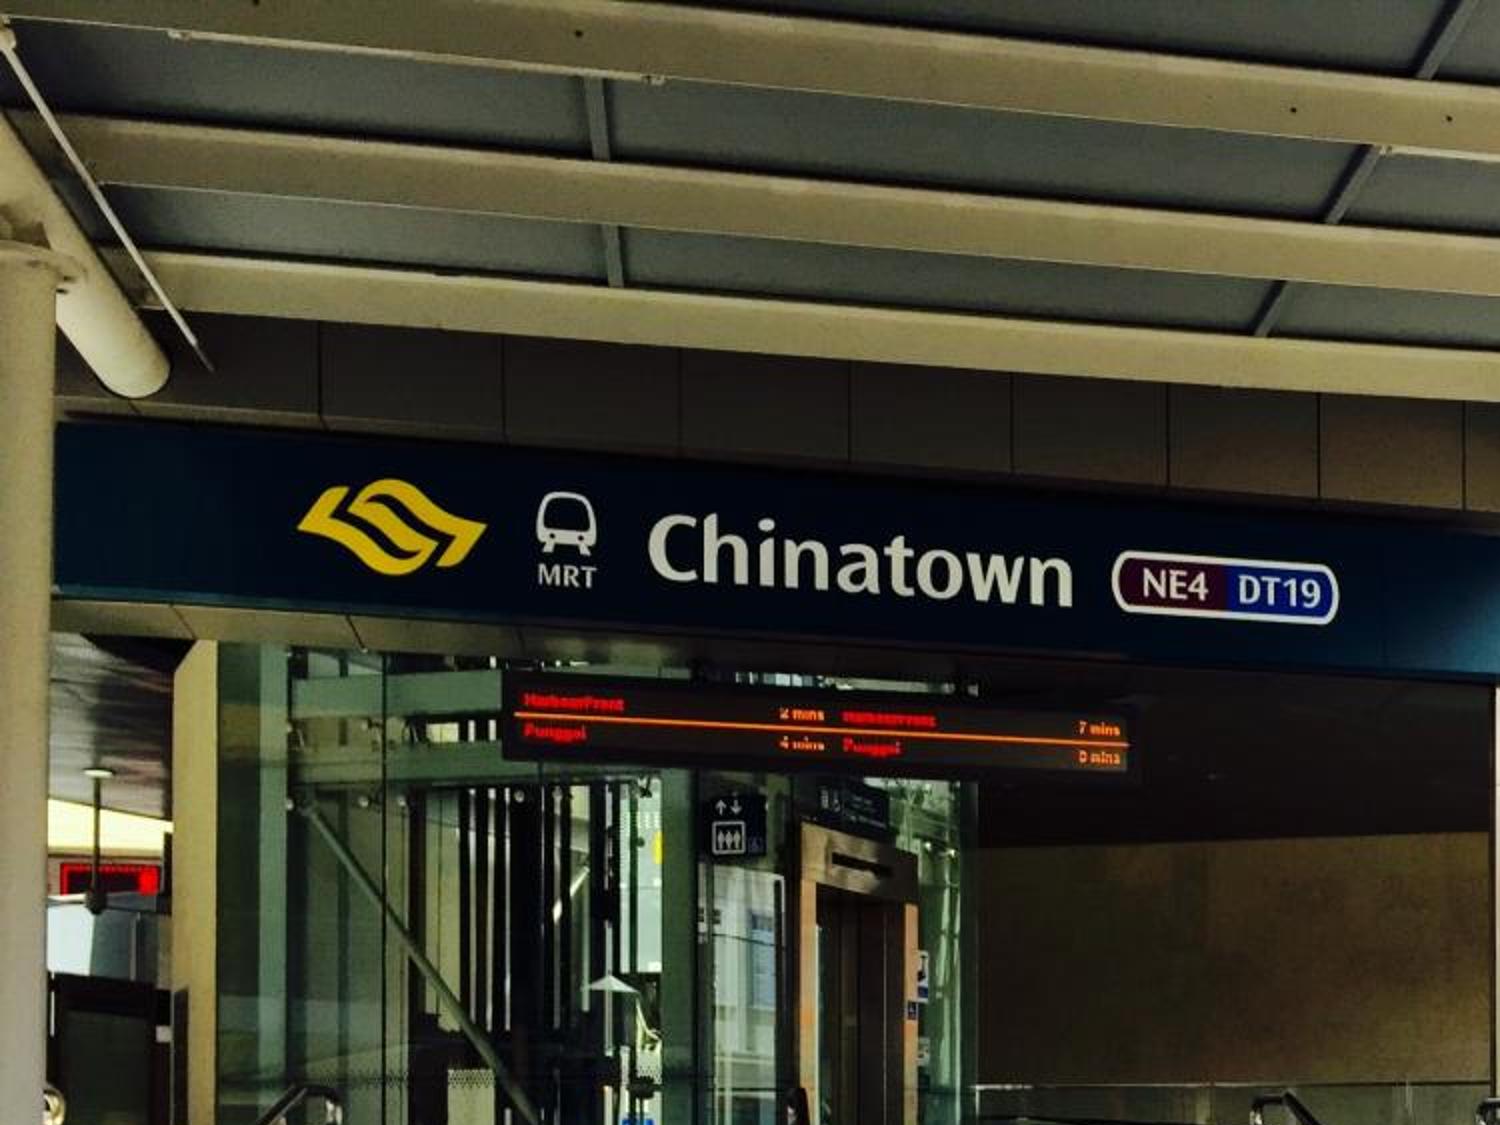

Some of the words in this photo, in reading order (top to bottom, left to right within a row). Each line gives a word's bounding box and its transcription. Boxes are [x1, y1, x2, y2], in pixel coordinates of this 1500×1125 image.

[648, 513, 1073, 608] Chinatown
[538, 563, 597, 589] MRT
[1142, 568, 1209, 601] NE4
[1238, 574, 1321, 608] DT19
[793, 708, 825, 721] mins
[1079, 720, 1088, 735] 7
[1090, 721, 1121, 736] mins
